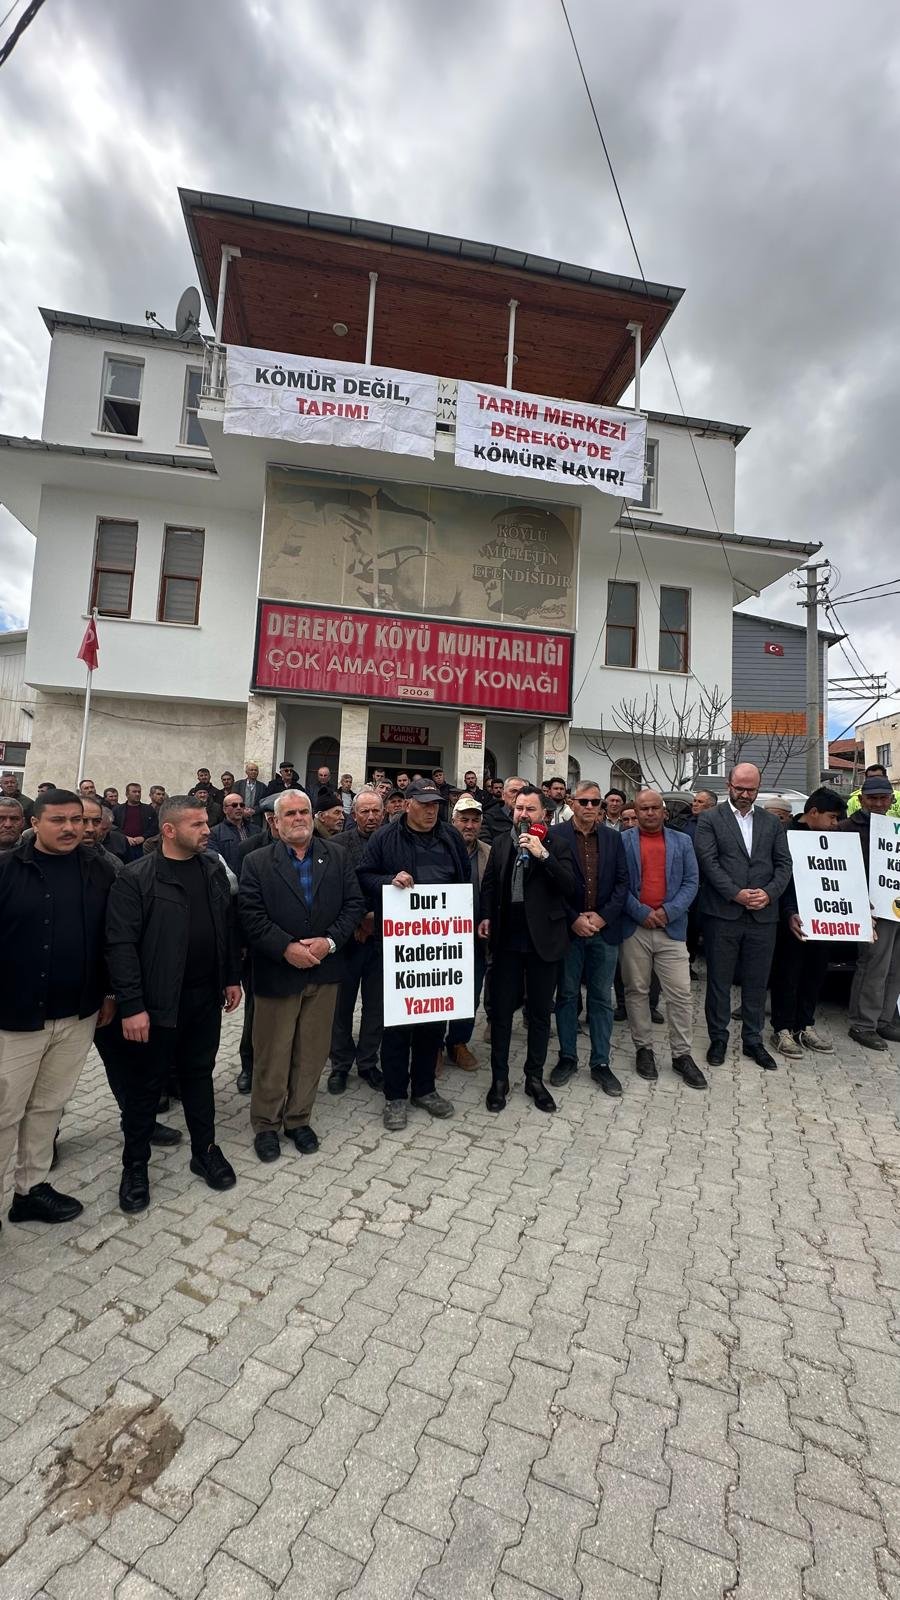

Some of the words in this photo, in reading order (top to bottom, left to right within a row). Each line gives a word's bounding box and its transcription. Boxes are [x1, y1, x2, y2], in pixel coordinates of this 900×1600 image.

[255, 365, 336, 393] KÖMÜR
[343, 378, 410, 405] DEĞİL,
[296, 397, 369, 420] TARIM!
[477, 394, 538, 420] TARIM
[543, 406, 627, 441] MERKEZİ
[491, 421, 611, 461] DEREKÖY'DE
[474, 442, 557, 471] KÖMÜRE
[562, 460, 625, 486] HAYIR!
[497, 522, 548, 541] KÖYLÜ
[267, 612, 368, 645] DEREKÖY
[375, 621, 430, 652] KÖYÜ
[438, 632, 563, 666] MUHTARLIĞI
[268, 649, 320, 672] ÇOK
[327, 655, 415, 682] AMAÇLI
[422, 662, 468, 684] KÖY
[475, 670, 558, 694] KONAĞI
[402, 688, 430, 697] 2004
[819, 835, 829, 850] O
[878, 838, 893, 852] Ne
[807, 856, 847, 871] Kadın
[821, 877, 839, 892] Bu
[410, 893, 438, 910] Dur
[814, 898, 853, 915] Ocağı
[384, 916, 473, 937] Dereköy'ün
[811, 919, 860, 936] Kapatır
[395, 942, 463, 963] Kaderini
[395, 968, 463, 989] Kömürle
[404, 996, 455, 1015] Yazma
